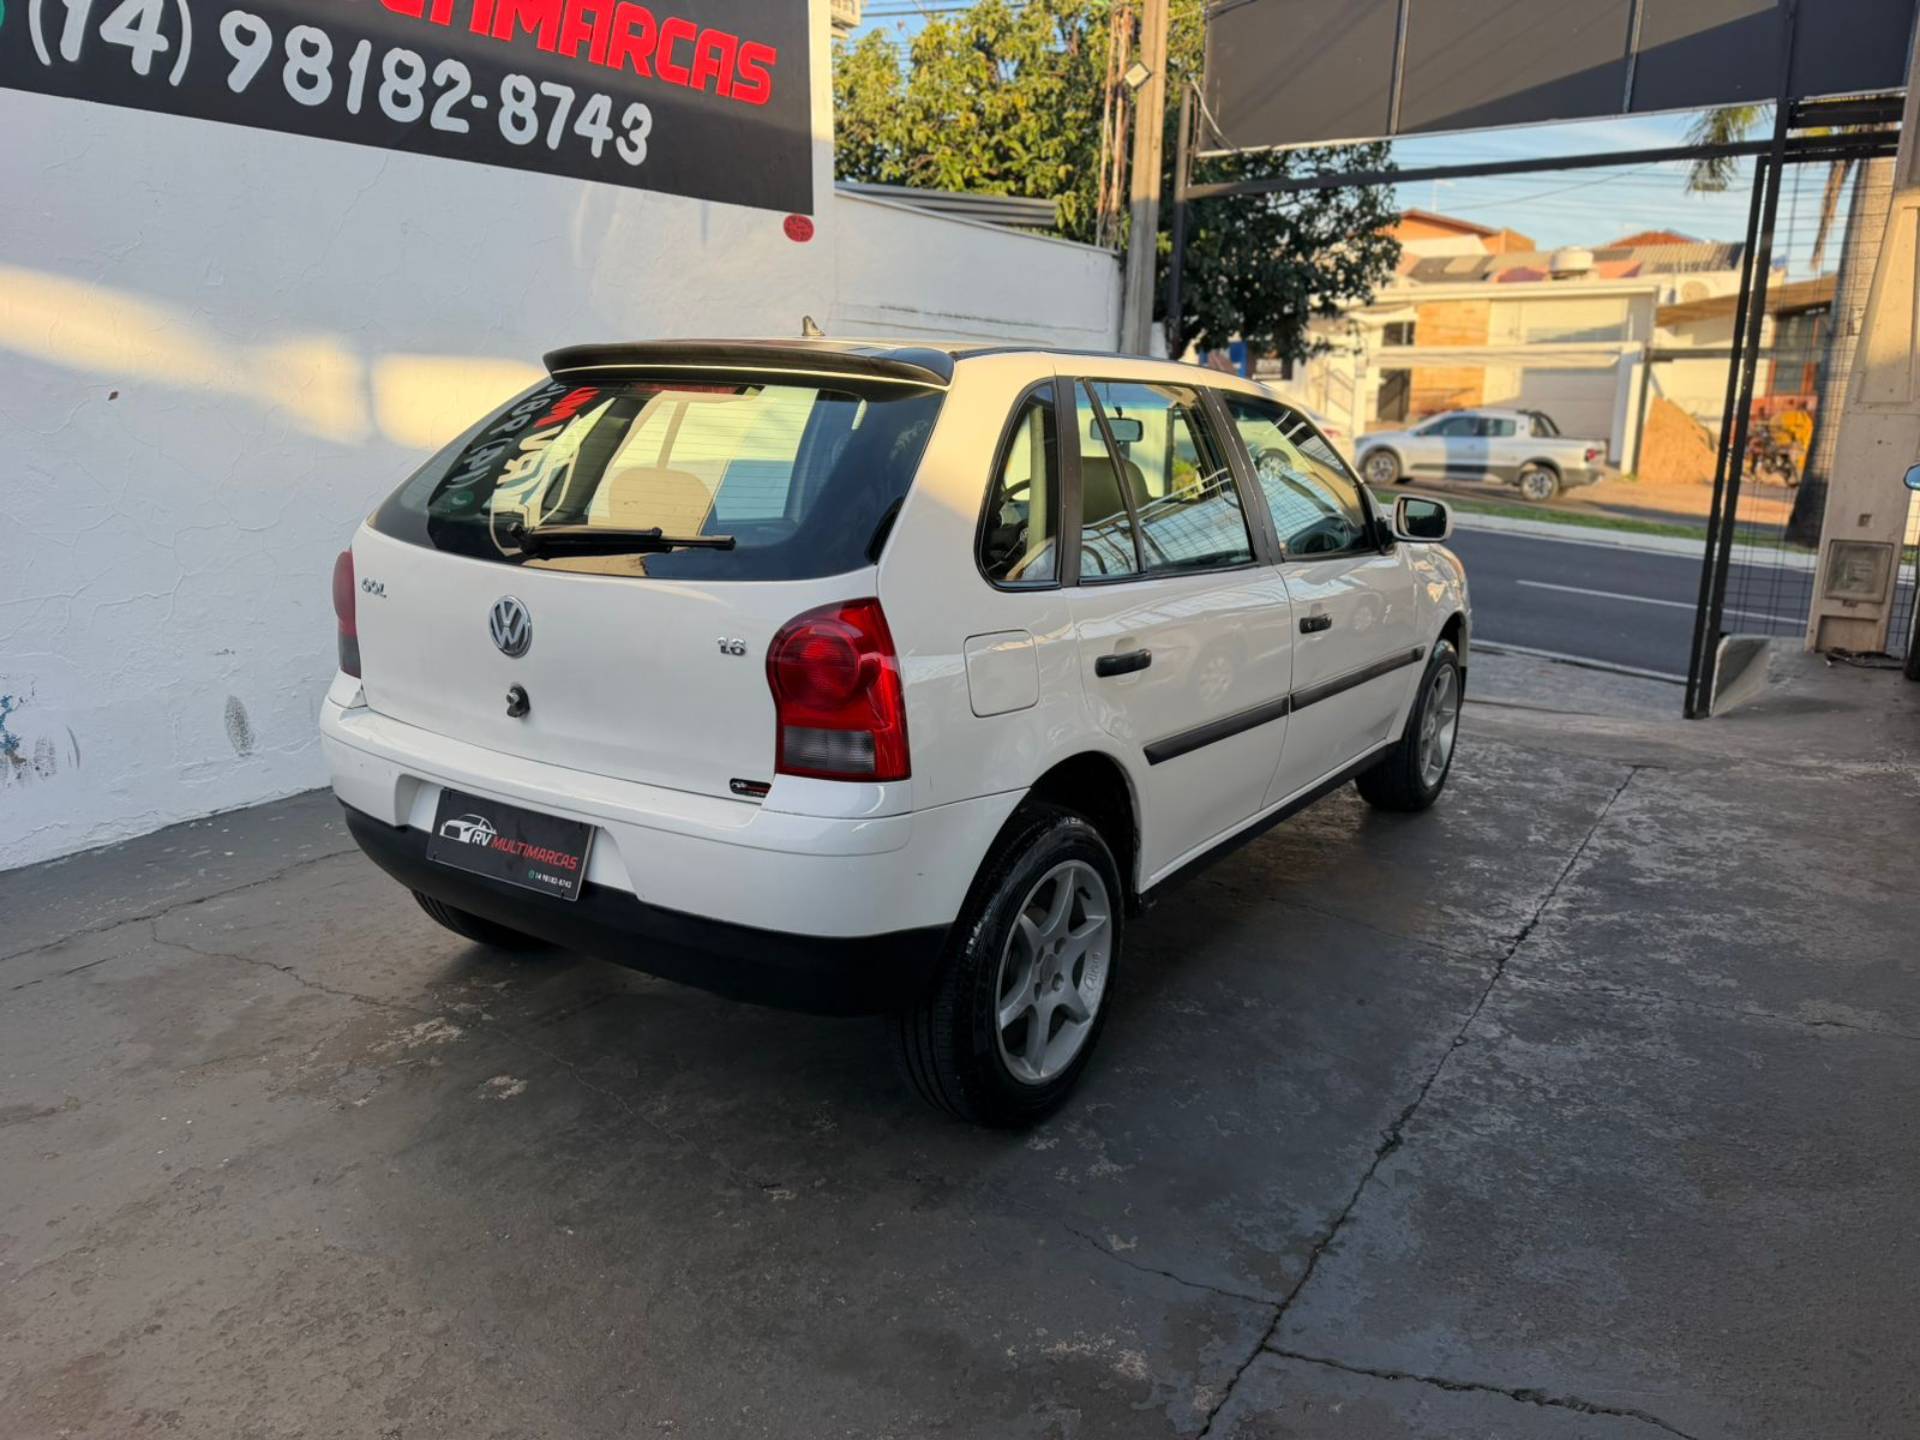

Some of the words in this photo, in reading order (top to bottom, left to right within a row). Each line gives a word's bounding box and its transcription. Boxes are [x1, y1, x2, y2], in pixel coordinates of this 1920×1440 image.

[219, 10, 653, 165] 98182-8743
[472, 832, 490, 846] RV
[492, 836, 578, 870] MULTIMARCAS
